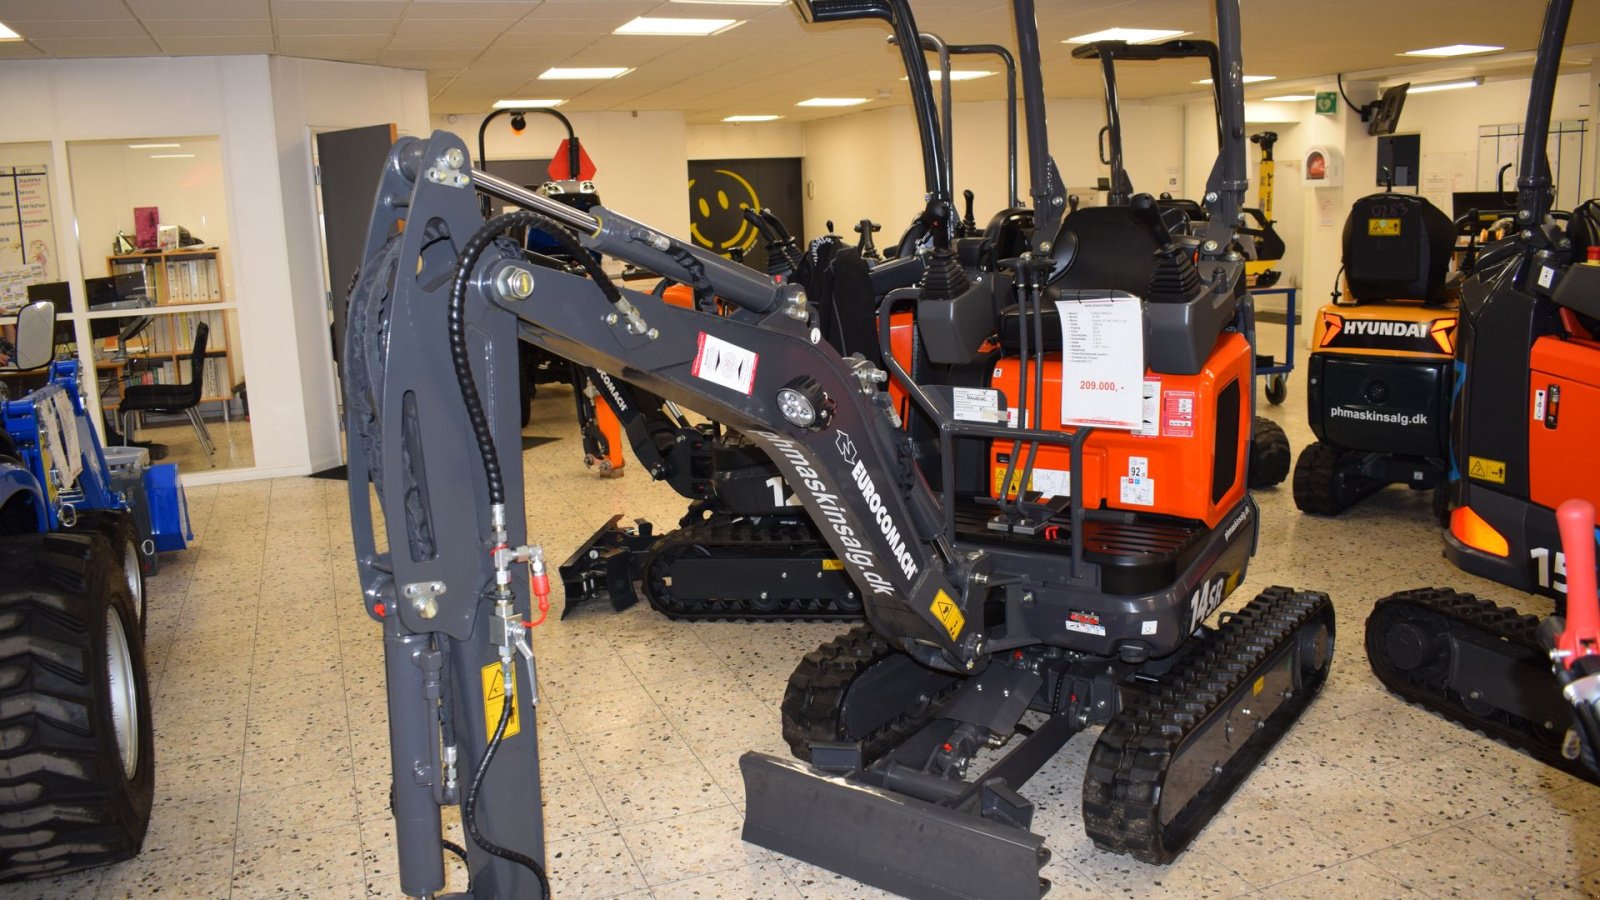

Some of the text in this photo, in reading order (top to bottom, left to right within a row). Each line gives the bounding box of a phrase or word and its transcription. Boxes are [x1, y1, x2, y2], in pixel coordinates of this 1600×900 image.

[1344, 320, 1428, 339] HYUNDAI
[1331, 406, 1428, 426] phmaskinsalg.dk
[1130, 466, 1141, 477] 92
[747, 429, 895, 596] phmaskinsalg.dk
[851, 459, 917, 581] EUROCOMACH
